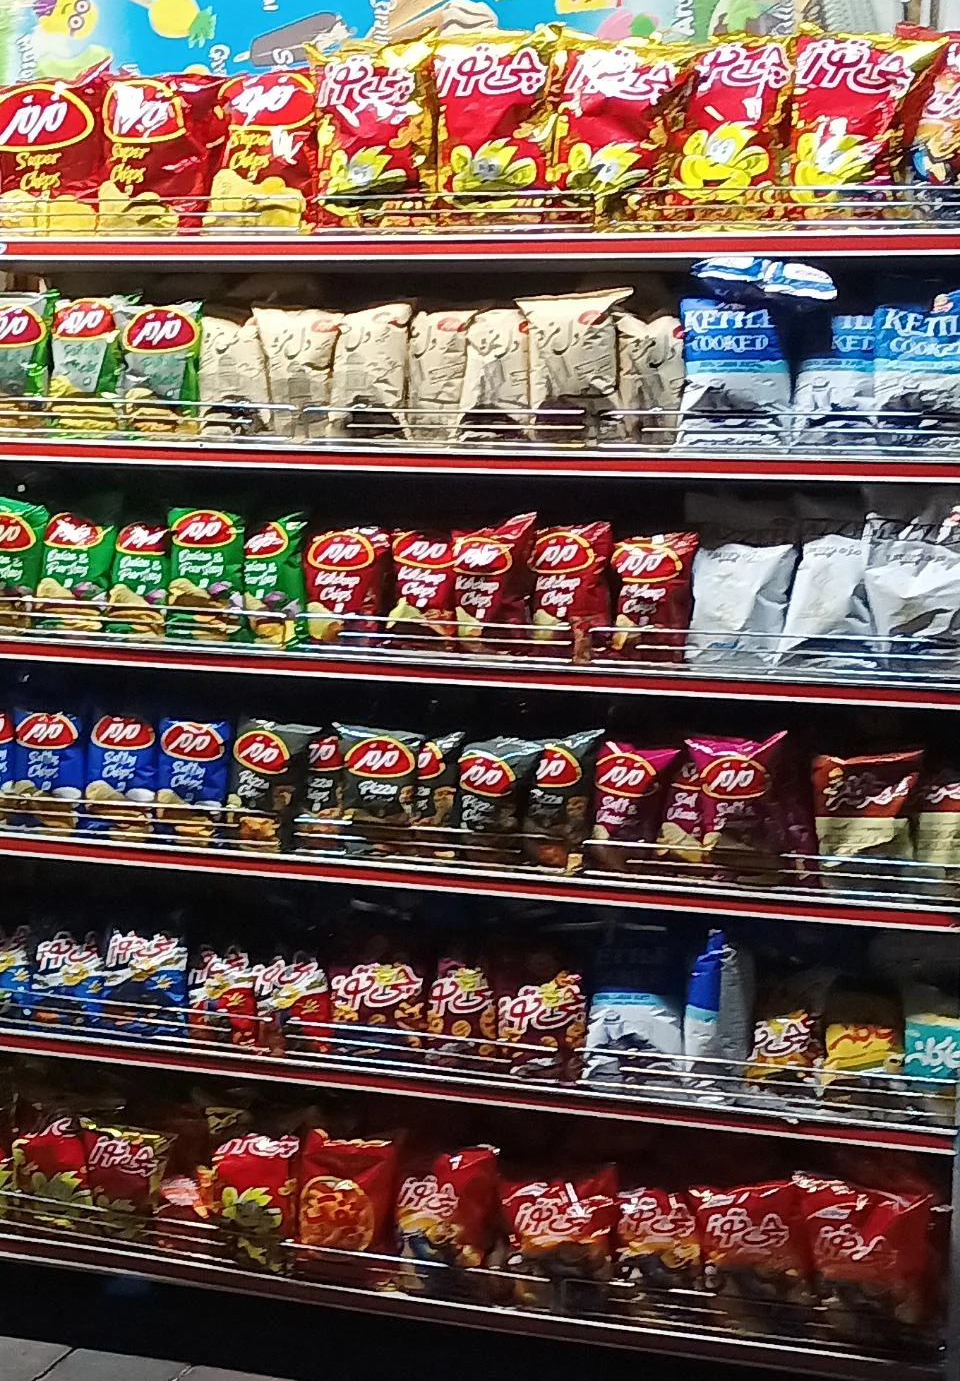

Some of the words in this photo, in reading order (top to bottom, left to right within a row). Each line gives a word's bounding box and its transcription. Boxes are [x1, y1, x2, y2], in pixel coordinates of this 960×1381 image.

[16, 152, 62, 170] Super
[20, 172, 61, 191] Chips
[883, 308, 960, 337] KETTL
[691, 334, 769, 351] COOKED
[831, 335, 875, 353] KED
[178, 515, 223, 542] مزمز
[315, 537, 362, 564] مزمز
[538, 537, 579, 567] مزمز
[239, 736, 280, 763] مزمز
[353, 743, 400, 771] مزمز
[460, 757, 504, 786] مزمز
[598, 759, 646, 788] مزمز
[708, 760, 755, 792] مزمز
[358, 779, 399, 795] Pizza
